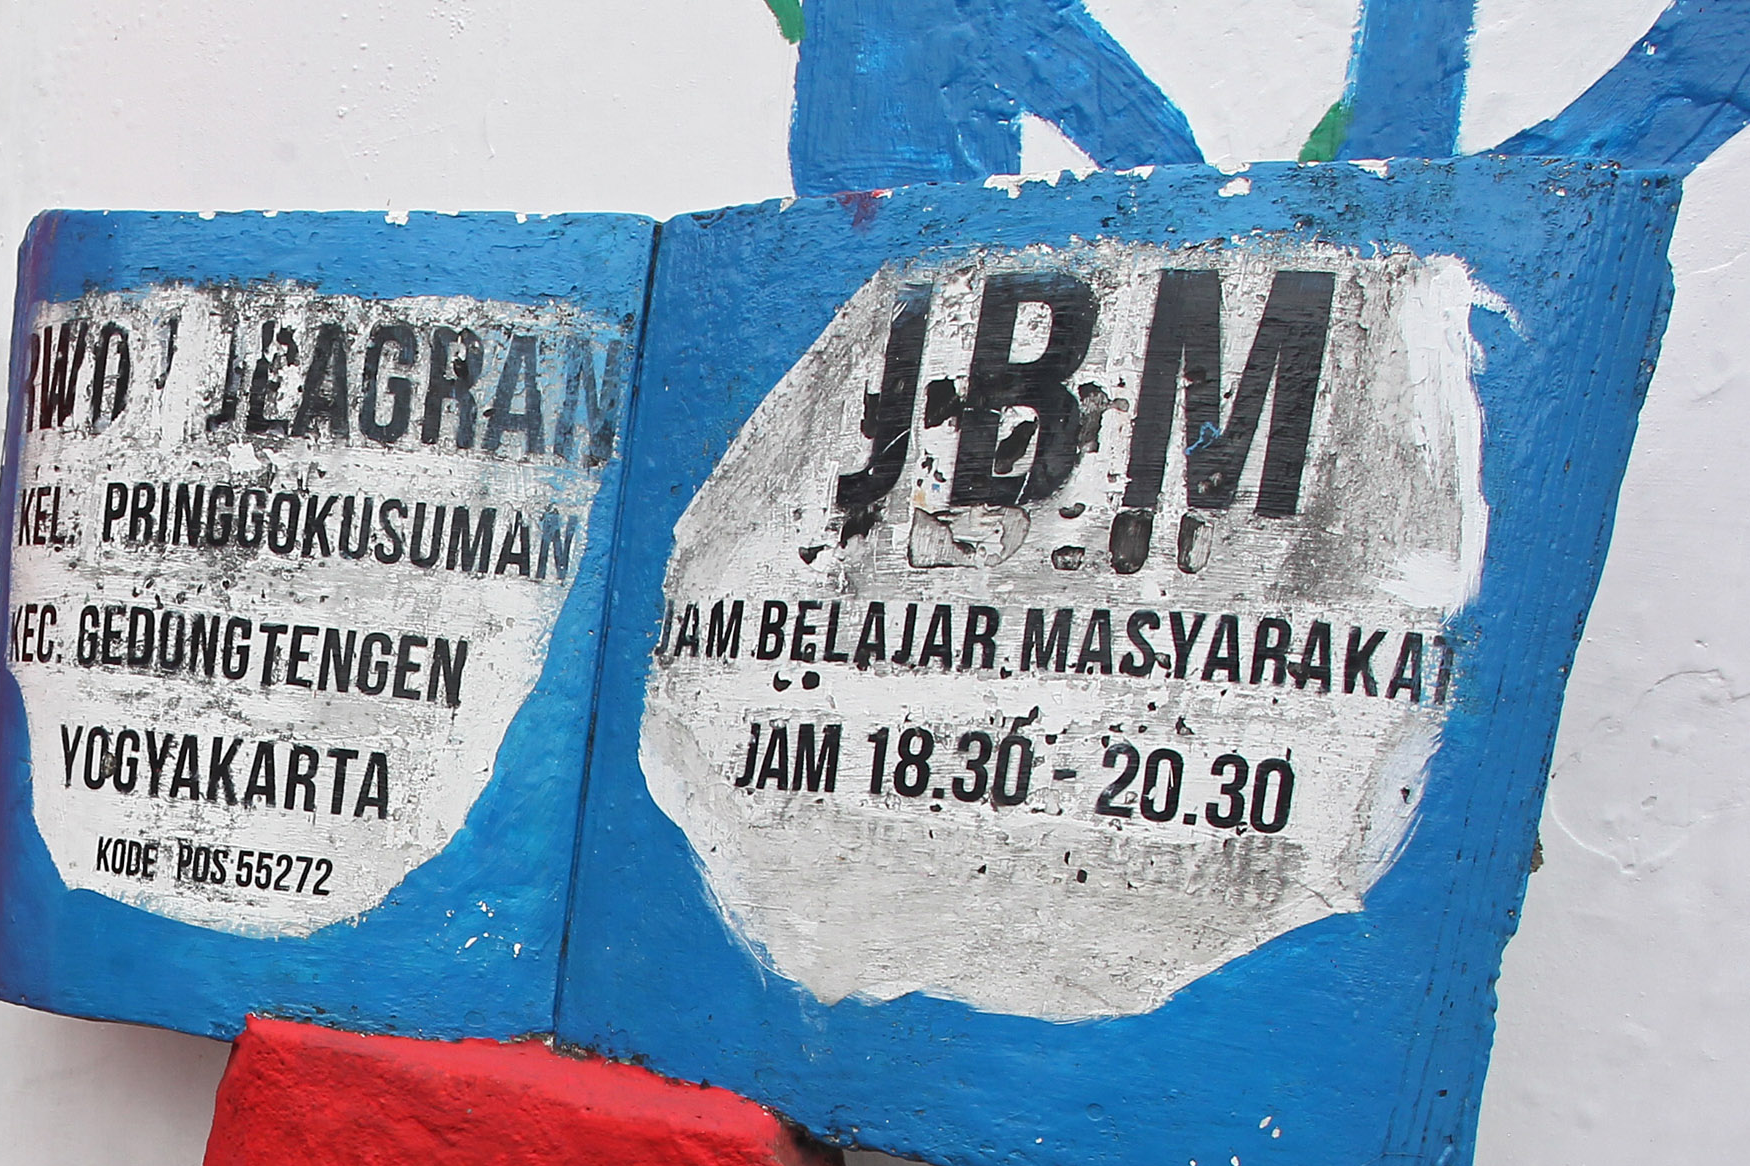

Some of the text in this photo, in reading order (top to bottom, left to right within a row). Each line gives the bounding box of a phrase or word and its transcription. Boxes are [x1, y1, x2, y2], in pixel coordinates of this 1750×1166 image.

[836, 268, 1337, 518] JBM
[103, 482, 577, 580] PRINGGOKUSUMAN
[10, 603, 469, 708] KEC. GEDONGTENGEN
[655, 600, 745, 660] JAM
[756, 600, 1000, 672] BELAJAR
[59, 724, 391, 822] YOGYAKARTA
[734, 722, 843, 794] JAM
[867, 726, 1034, 808] 18.30
[1095, 742, 1296, 834] 20.30
[96, 836, 333, 896] KODE POS 55272
